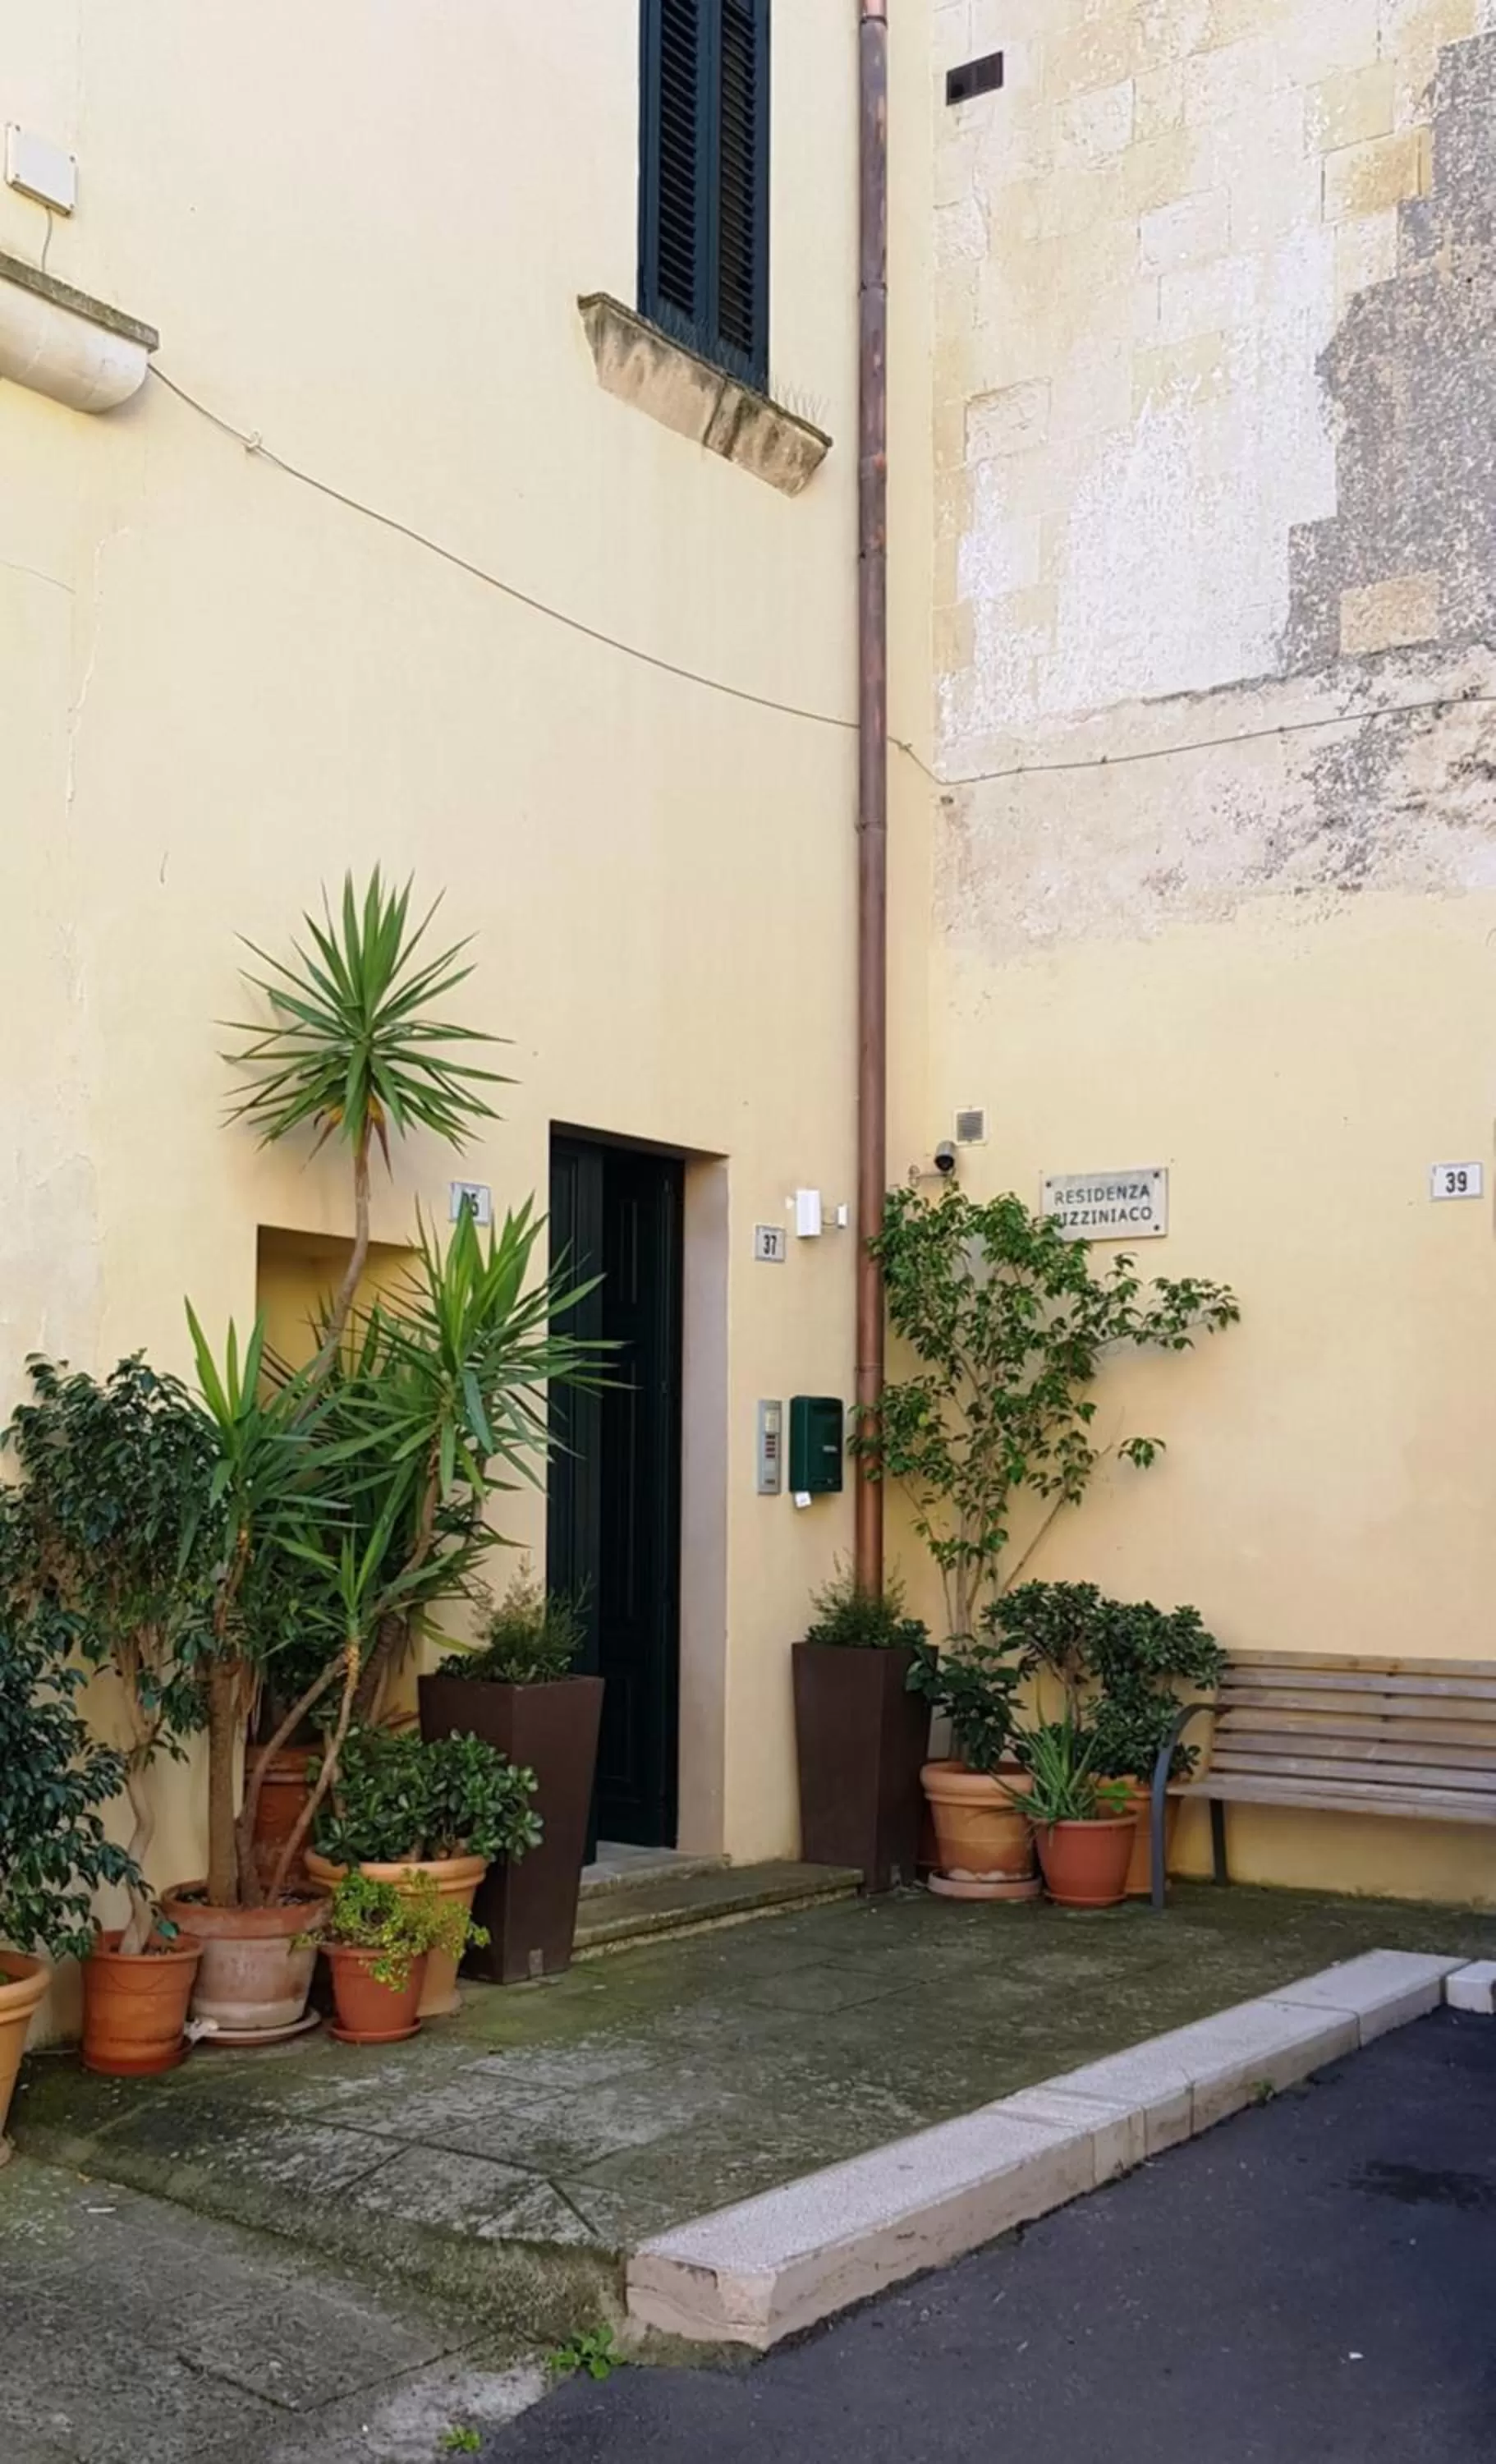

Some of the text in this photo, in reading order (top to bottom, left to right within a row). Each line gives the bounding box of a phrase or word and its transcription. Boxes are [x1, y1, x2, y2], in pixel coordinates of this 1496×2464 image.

[1445, 1170, 1467, 1193] 39
[1055, 1184, 1150, 1205] RESIDENZA
[764, 1234, 777, 1255] 37
